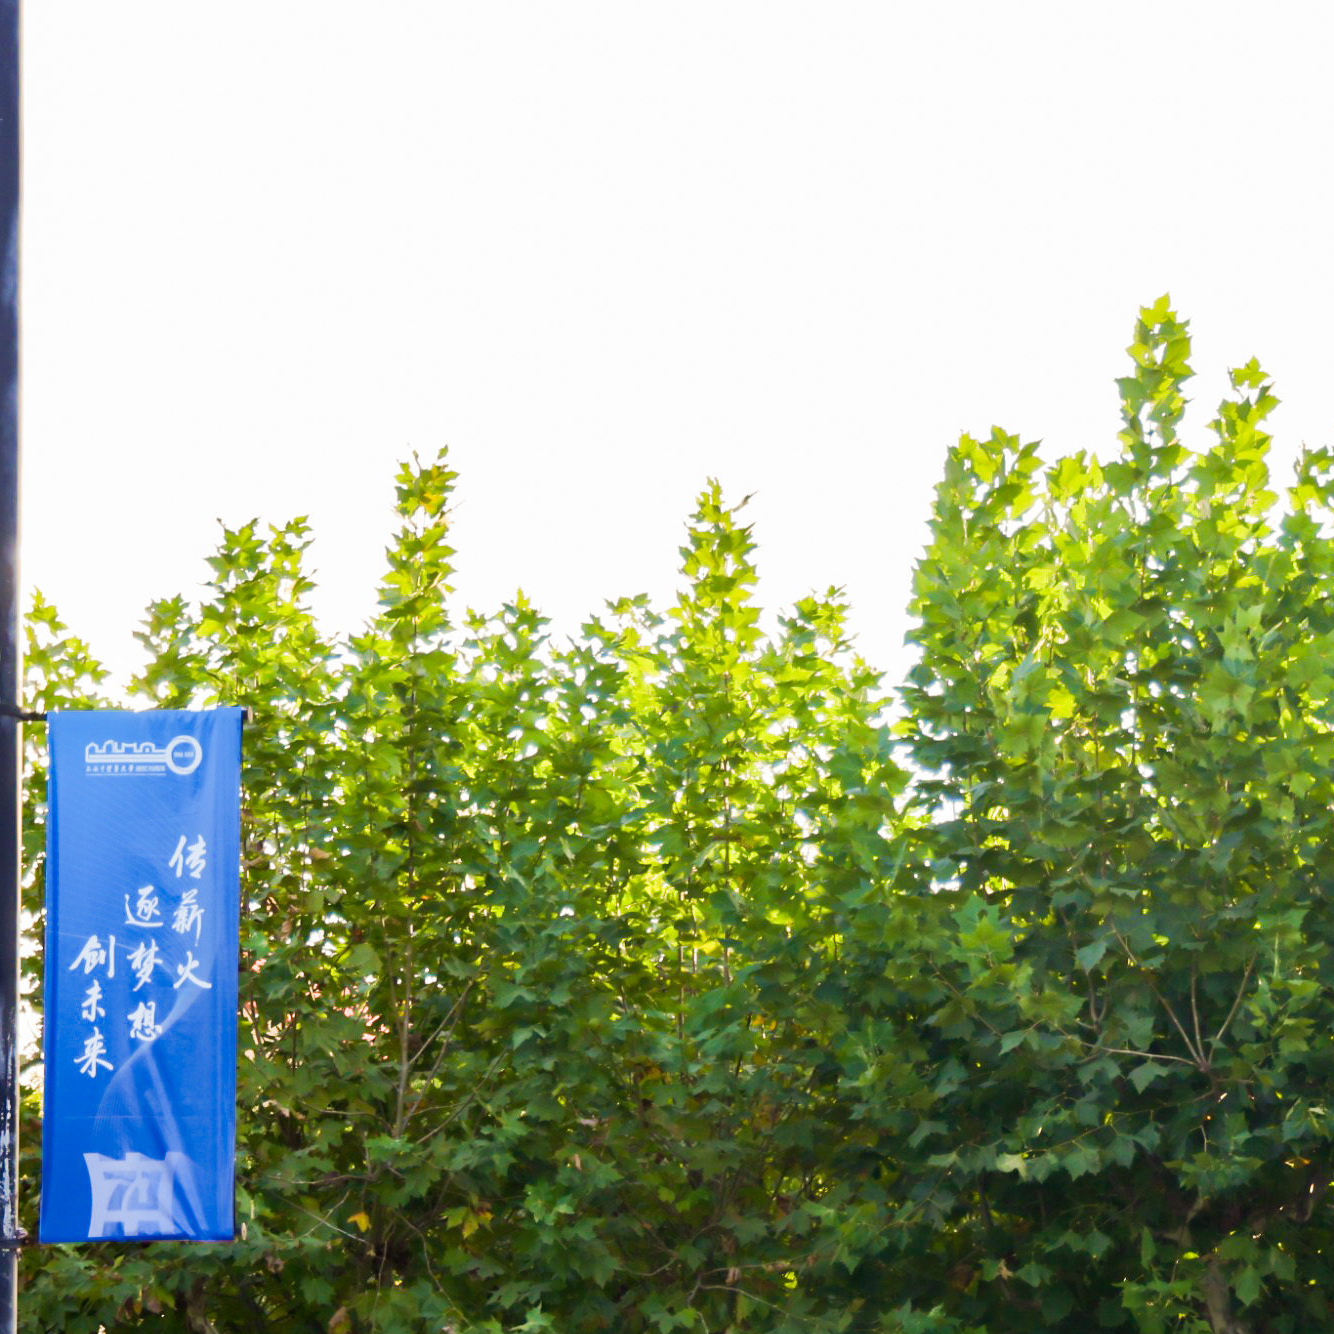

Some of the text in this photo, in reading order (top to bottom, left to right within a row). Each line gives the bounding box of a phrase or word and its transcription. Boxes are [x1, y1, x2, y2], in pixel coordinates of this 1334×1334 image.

[124, 885, 164, 1041] 逐梦想
[168, 834, 212, 989] 传薪火
[69, 934, 116, 1078] 创未来
